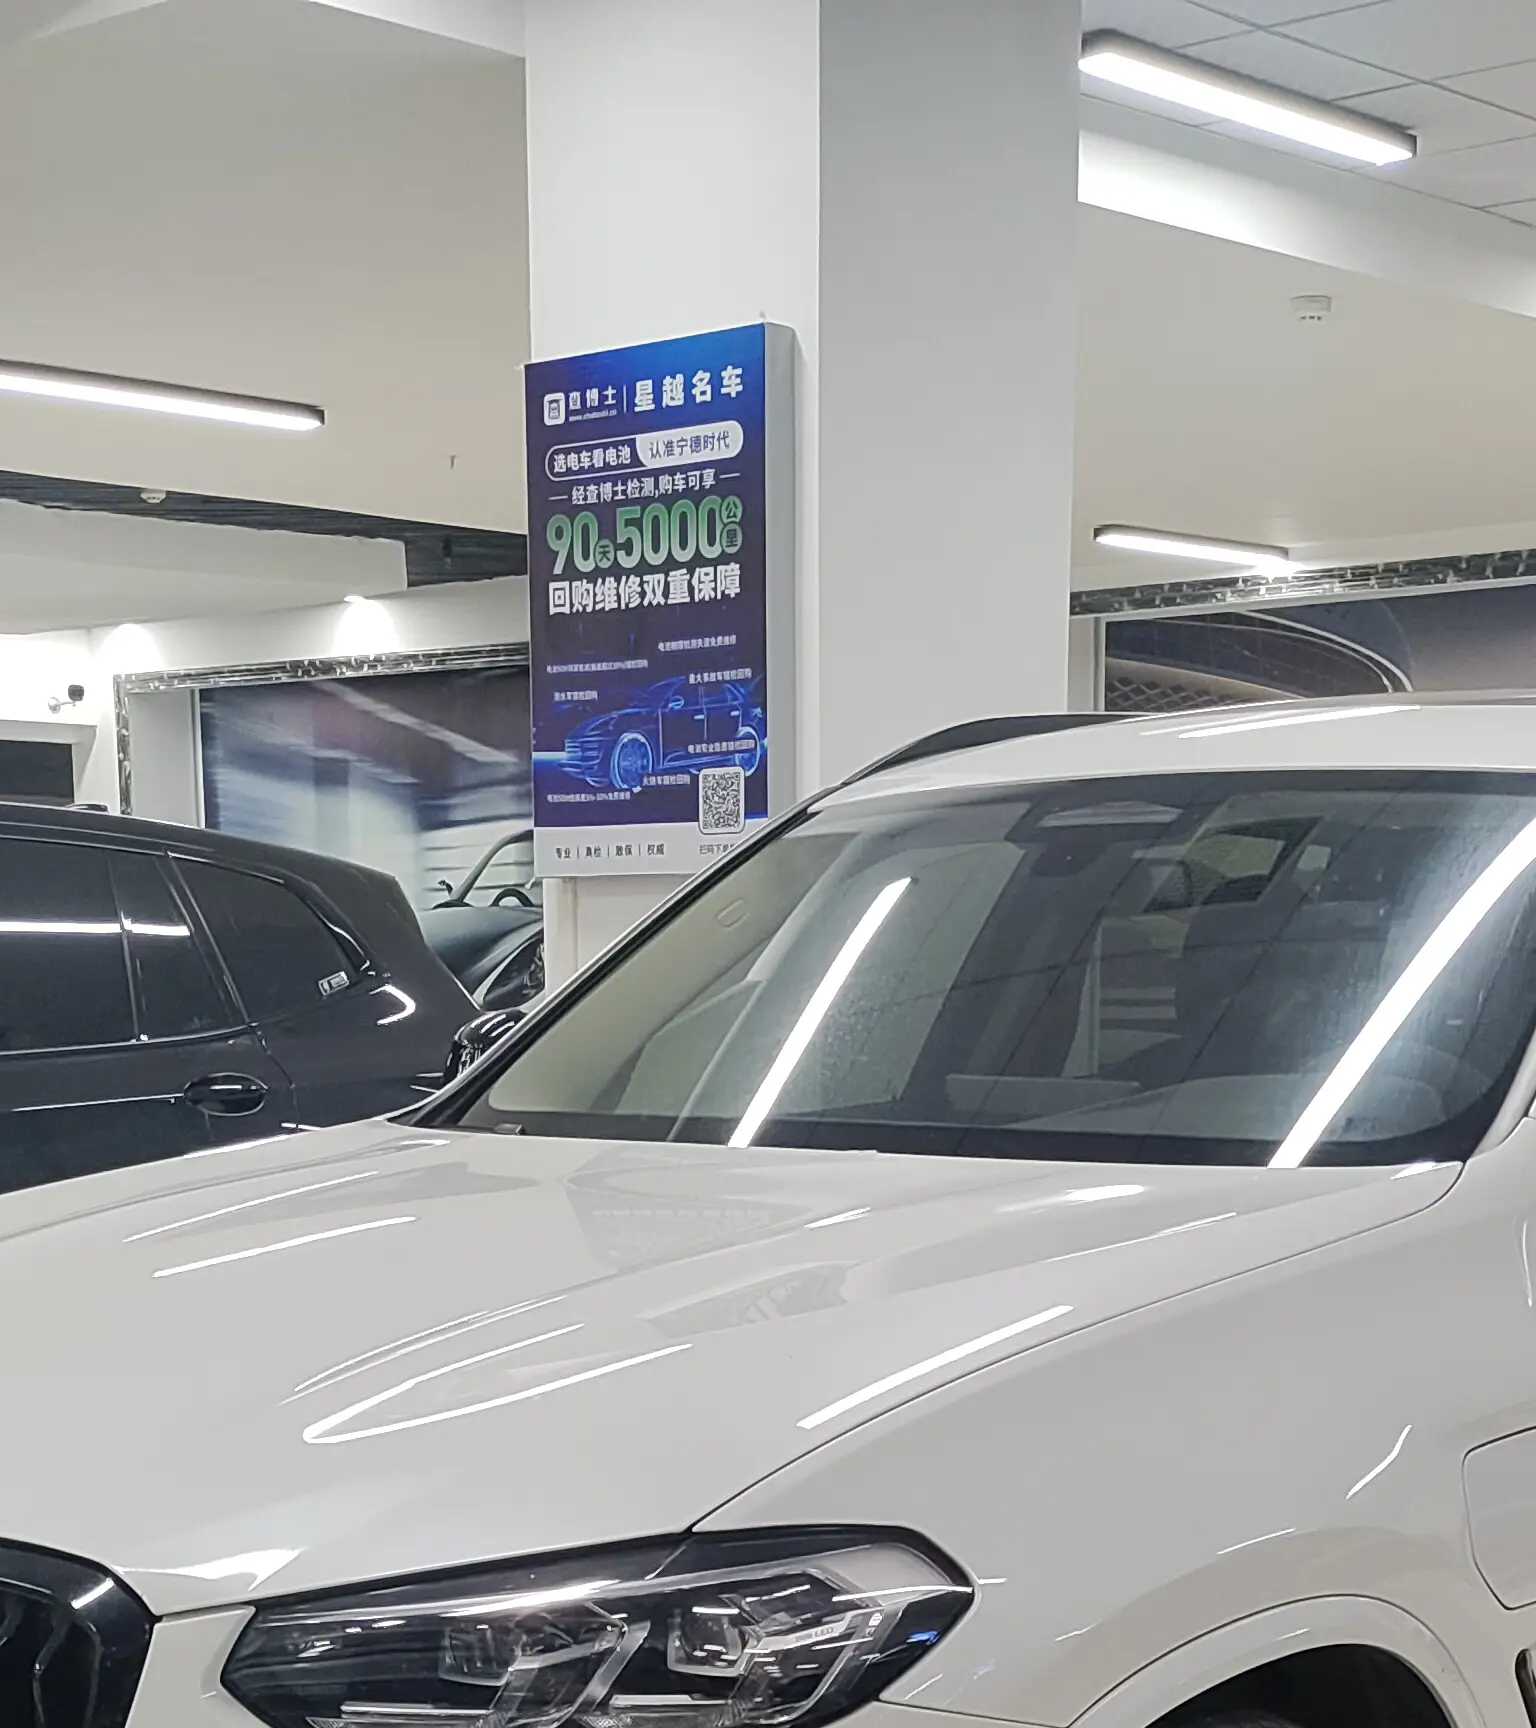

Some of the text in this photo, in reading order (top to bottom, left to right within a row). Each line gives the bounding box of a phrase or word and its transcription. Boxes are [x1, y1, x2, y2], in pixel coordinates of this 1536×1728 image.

[569, 386, 617, 410] 查博士
[634, 365, 743, 412] 星越名车
[553, 444, 632, 473] 选电车看电池
[648, 430, 730, 460] 认准宁德时代
[548, 562, 741, 616] 回购维修双重保障
[647, 843, 664, 856] 权威
